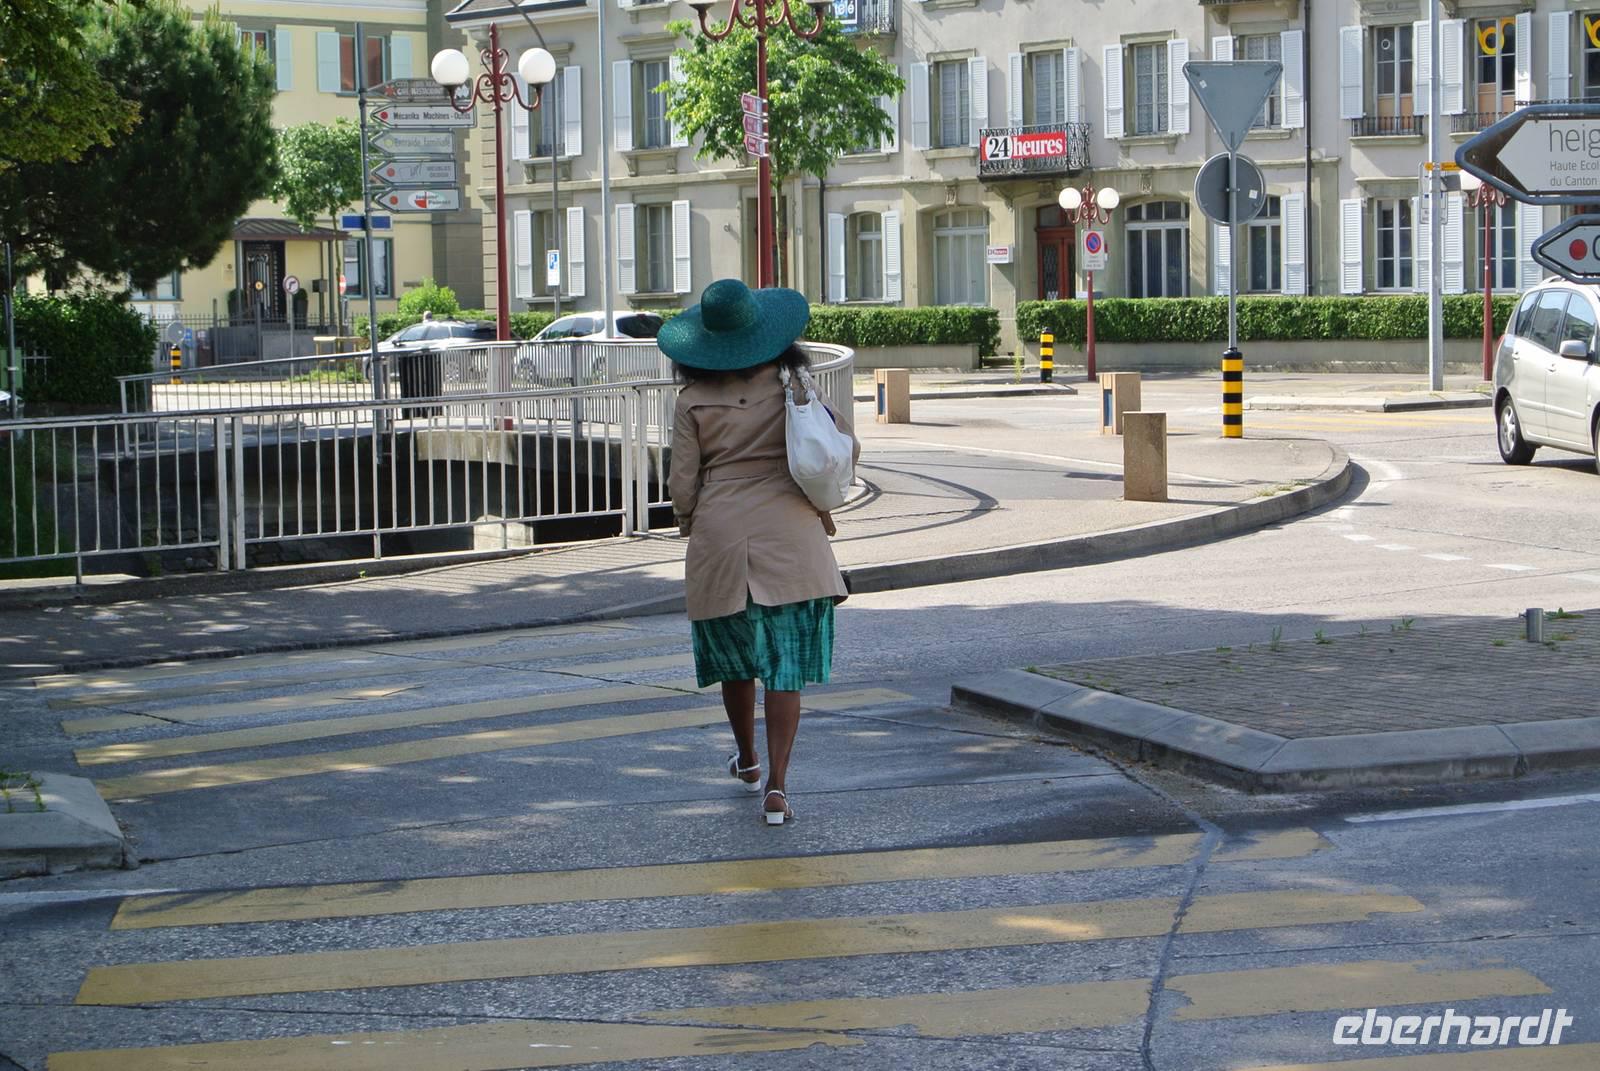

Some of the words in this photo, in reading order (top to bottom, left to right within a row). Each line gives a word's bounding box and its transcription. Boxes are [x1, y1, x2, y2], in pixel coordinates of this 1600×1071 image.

[423, 111, 449, 120] Machines
[1549, 122, 1600, 159] heig
[989, 137, 1009, 158] 24
[1013, 138, 1063, 156] heures
[1550, 160, 1577, 171] Haute
[1550, 176, 1562, 187] du
[1565, 176, 1598, 186] Canton
